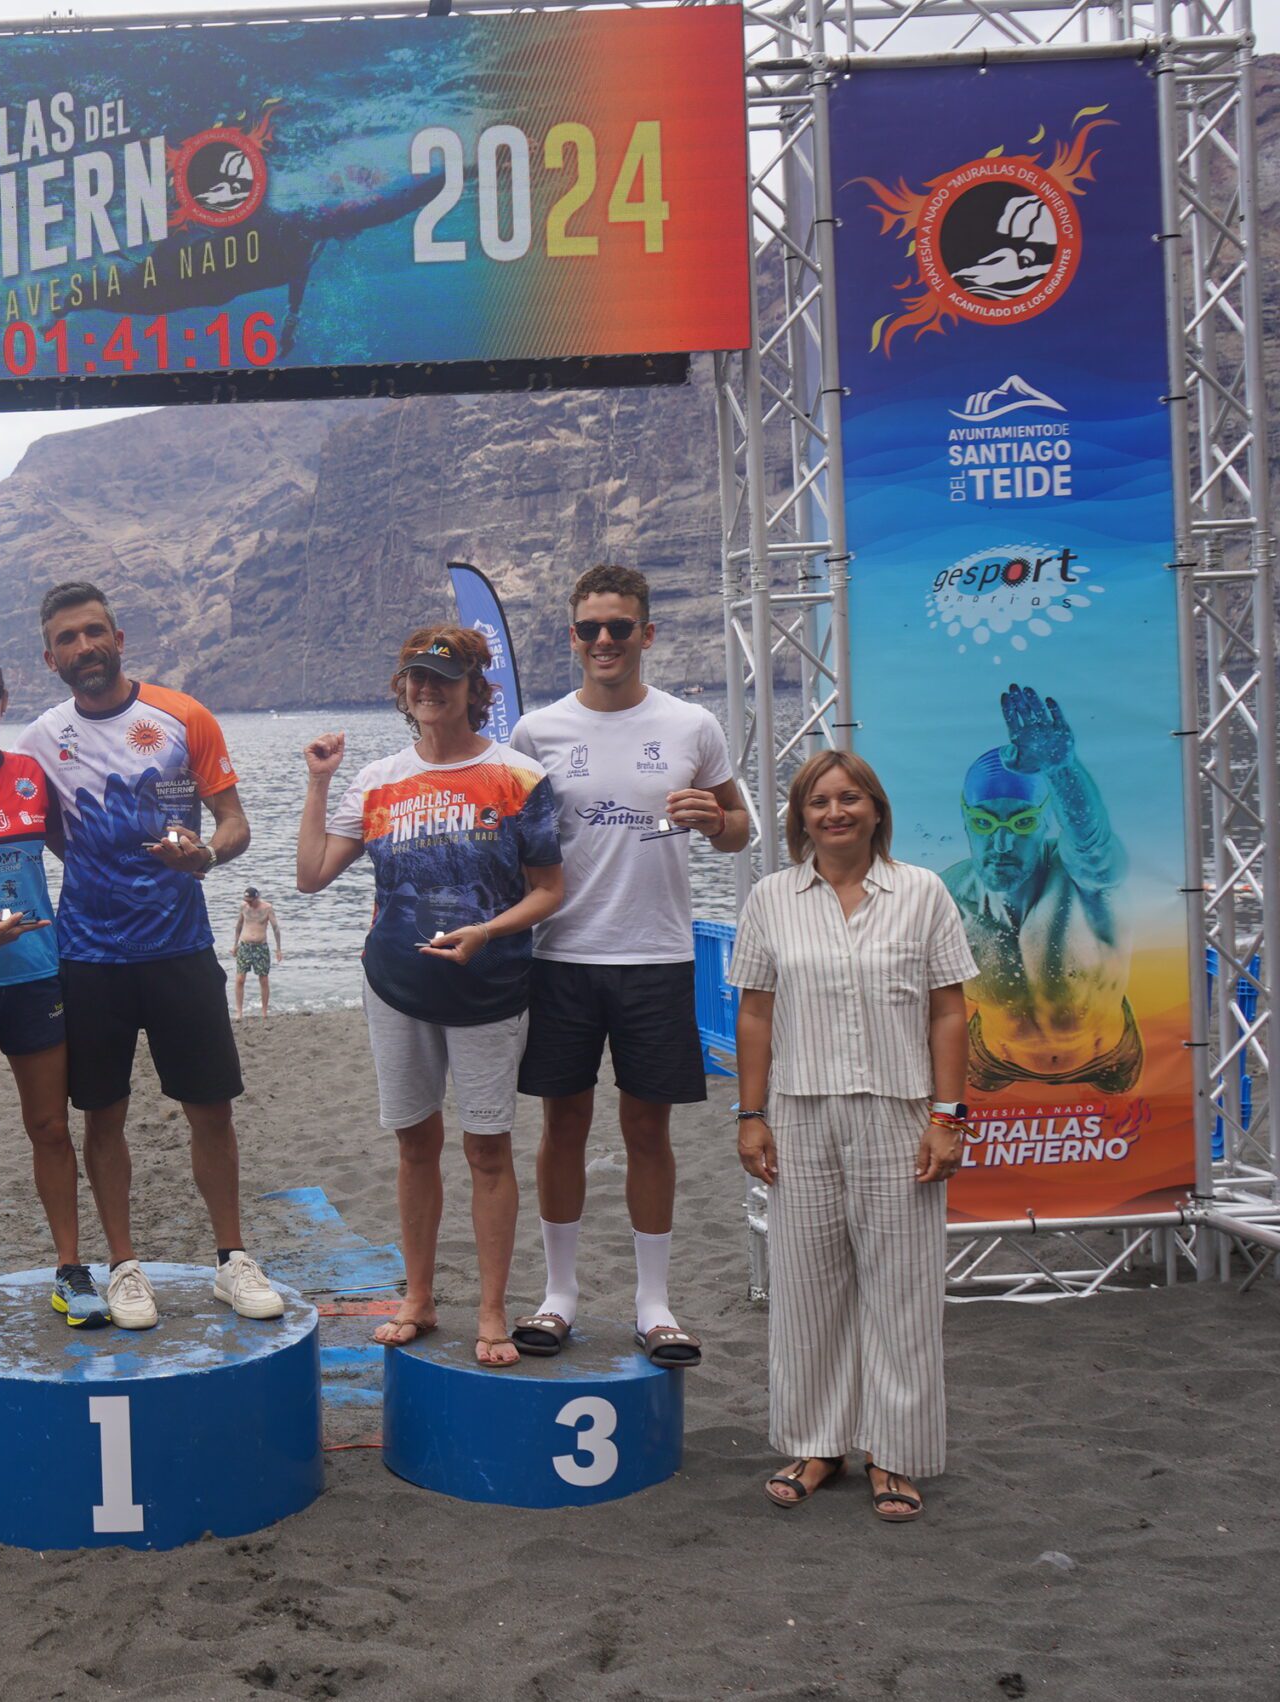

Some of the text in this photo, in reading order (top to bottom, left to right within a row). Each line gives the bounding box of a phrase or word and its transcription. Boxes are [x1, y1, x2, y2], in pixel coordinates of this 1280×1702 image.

[85, 98, 130, 142] DEL
[410, 120, 670, 263] 2024
[1018, 168, 1039, 186] DEL
[924, 188, 950, 224] NADO
[143, 257, 157, 289] A
[179, 230, 261, 280] NADO
[918, 236, 945, 292] TRAVESÍA
[948, 247, 1072, 317] ACANTILADO DE LOS GIGANTES
[3, 311, 277, 375] 01:41:16
[948, 440, 1072, 466] SANTIAGO
[950, 470, 966, 502] DEL
[968, 465, 1072, 500] TEIDE
[933, 548, 1078, 592] gesport
[390, 790, 466, 817] MURALLAS DEL
[588, 812, 654, 826] Anthus
[971, 1104, 1095, 1118] AVESÍA A NADO
[963, 1116, 1102, 1144] URALLAS
[985, 1138, 1128, 1166] INFIERNO
[552, 1396, 619, 1487] 3
[89, 1395, 144, 1533] 1
